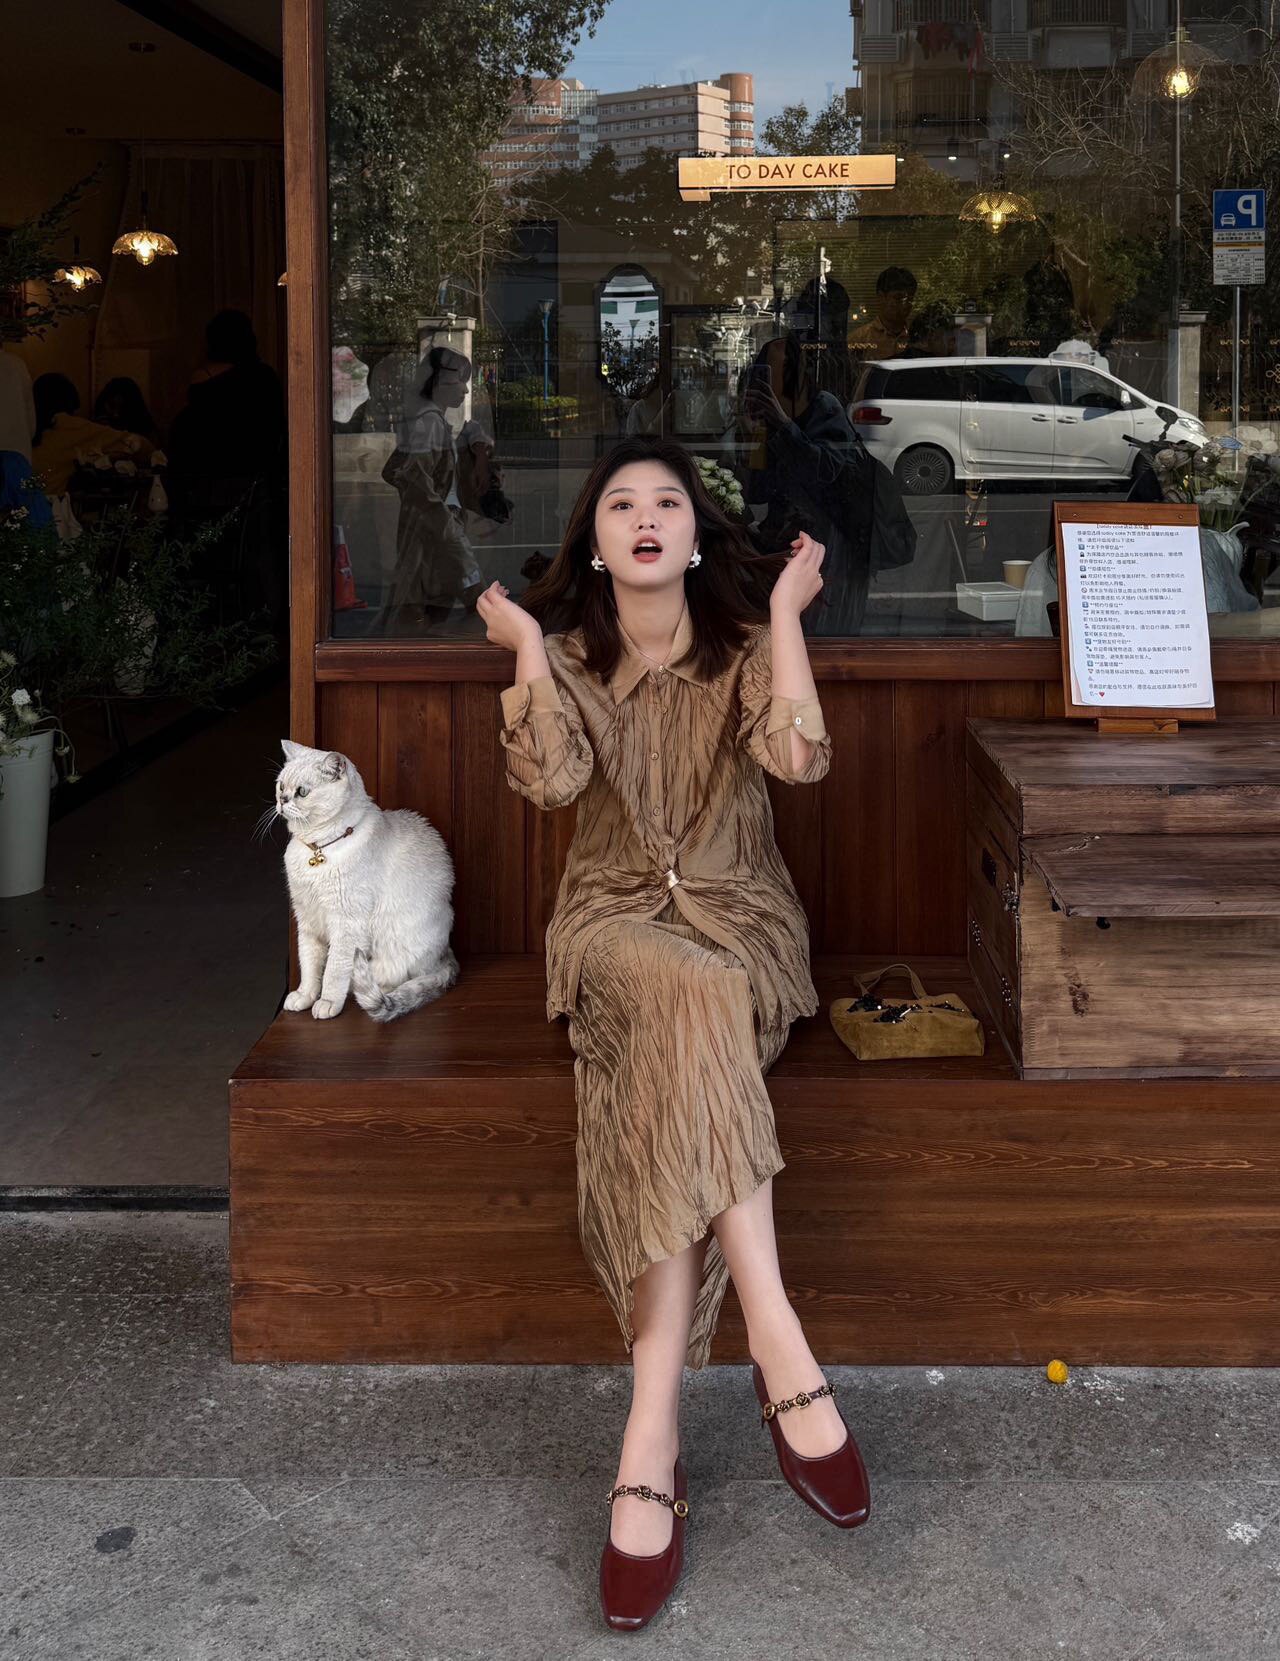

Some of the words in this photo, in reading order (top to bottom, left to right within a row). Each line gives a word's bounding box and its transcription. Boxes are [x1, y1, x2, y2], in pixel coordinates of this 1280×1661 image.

[726, 164, 751, 179] TO
[758, 163, 796, 179] DAY
[802, 163, 850, 178] CAKE
